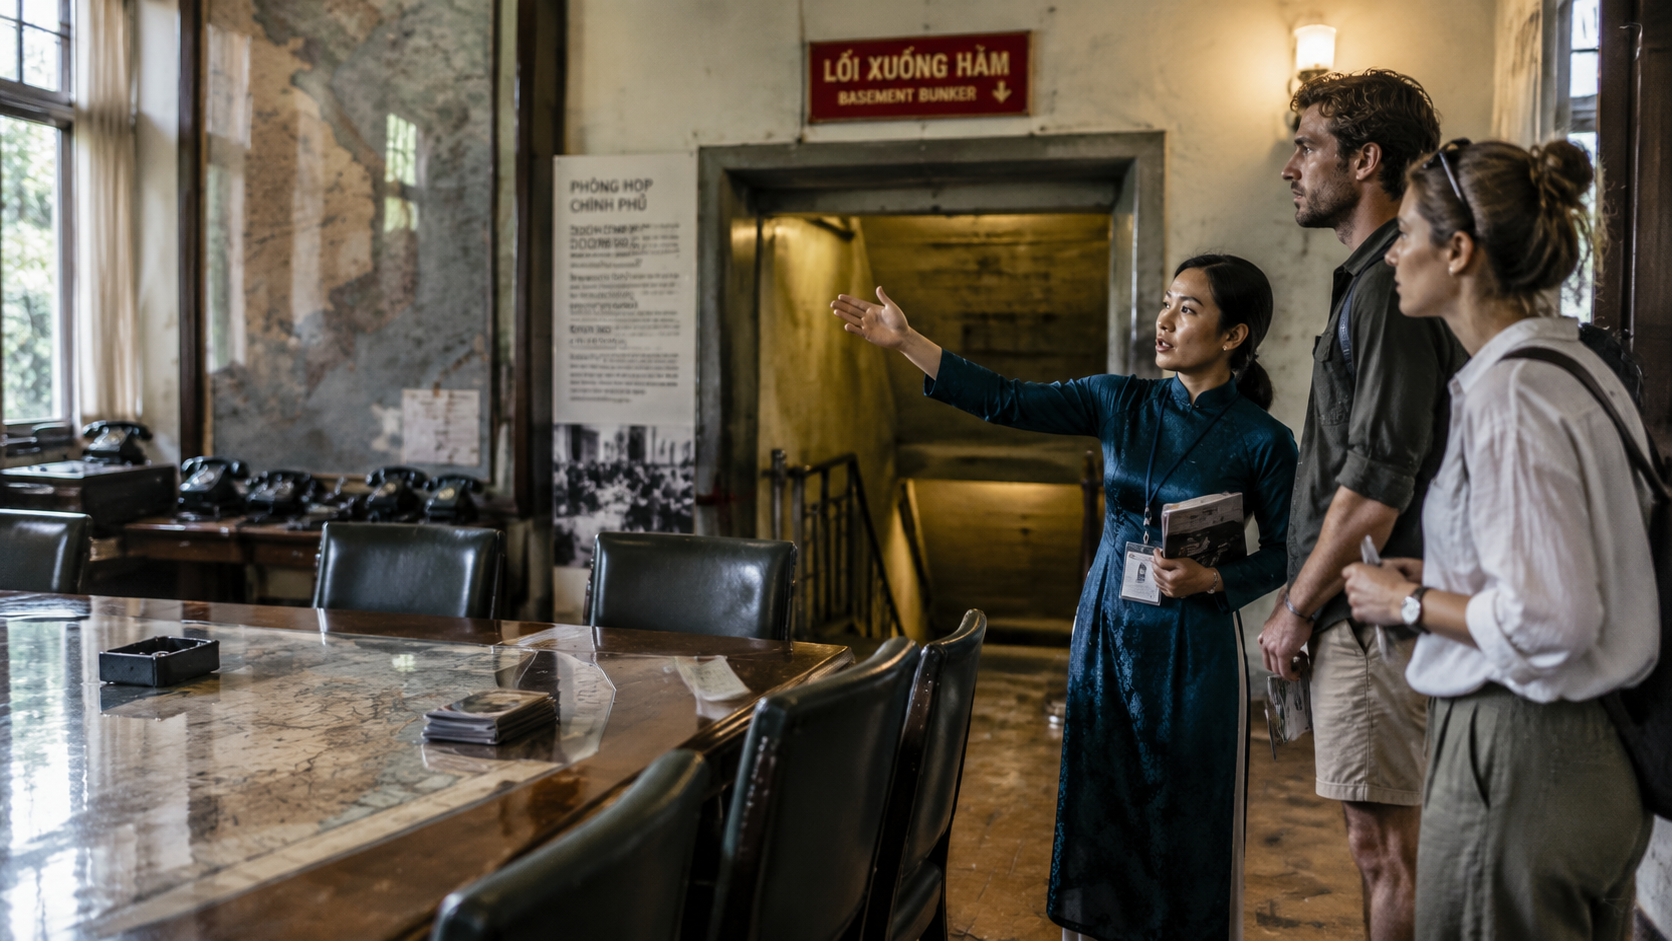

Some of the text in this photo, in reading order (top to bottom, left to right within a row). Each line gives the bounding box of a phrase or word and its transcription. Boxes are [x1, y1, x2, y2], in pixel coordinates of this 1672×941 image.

[823, 49, 860, 83] LỐI
[867, 45, 949, 82] XUỐNG
[838, 85, 977, 106] BASEMENT BUNKER
